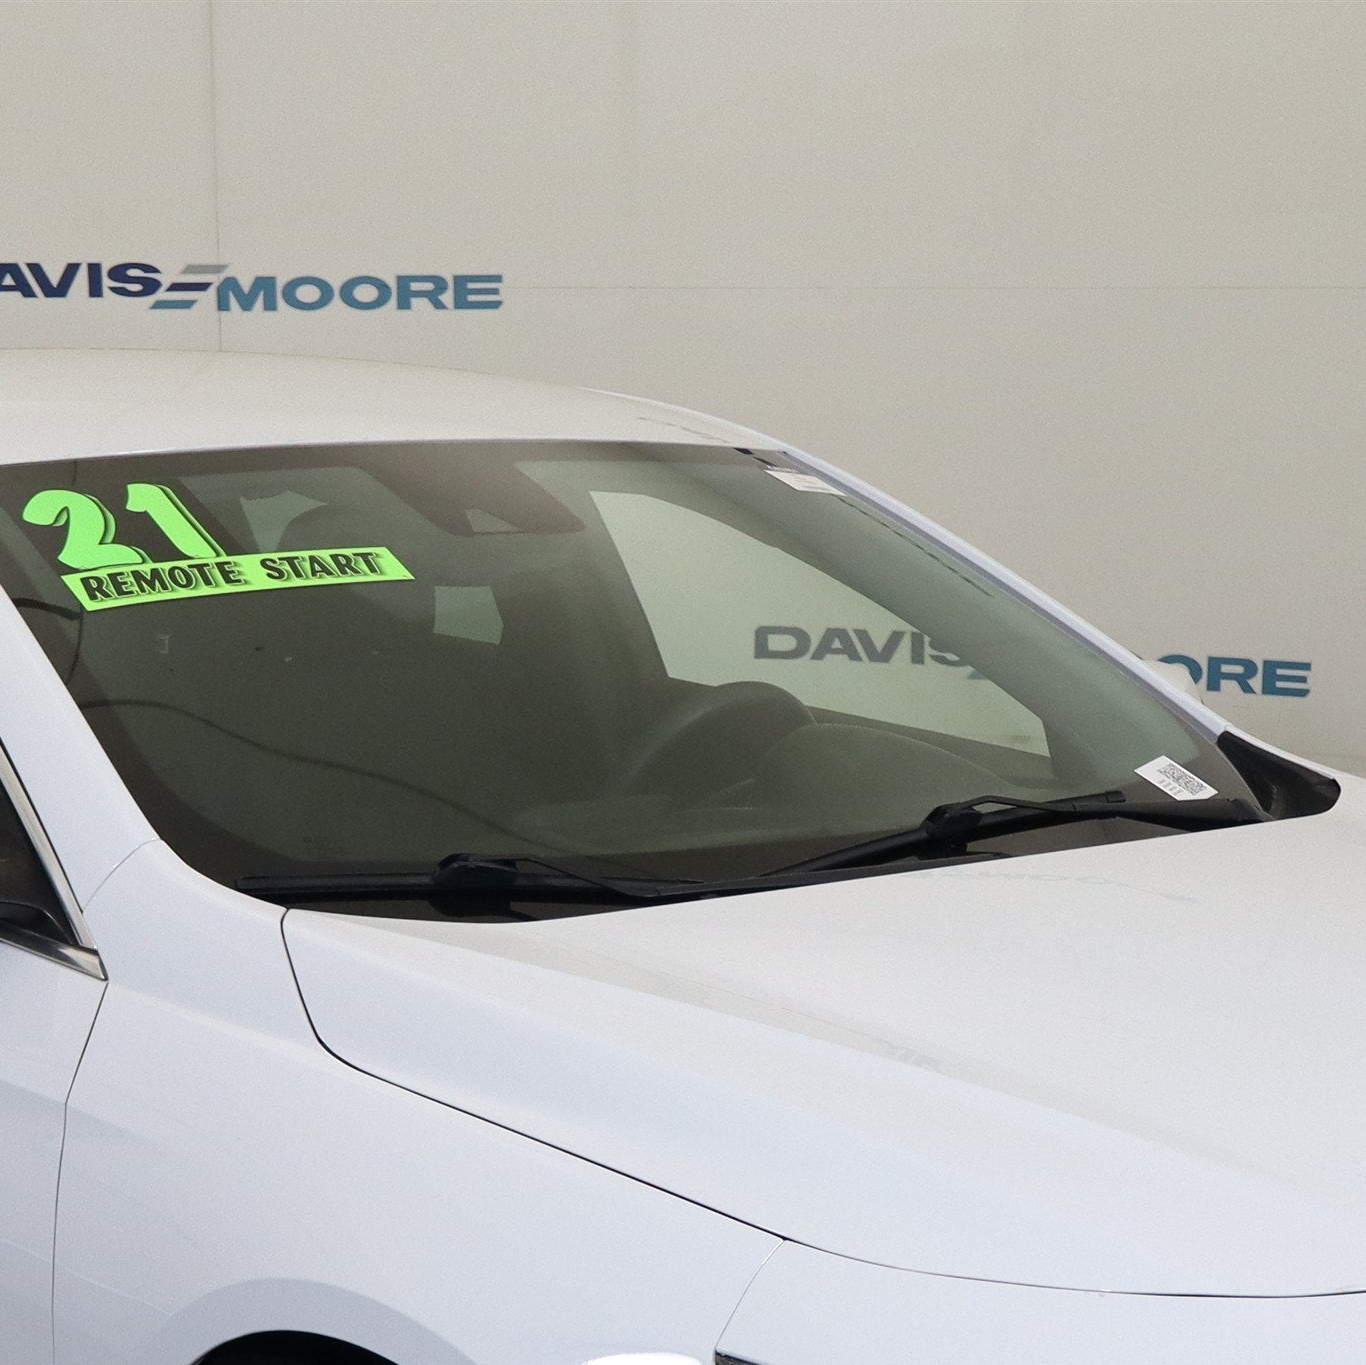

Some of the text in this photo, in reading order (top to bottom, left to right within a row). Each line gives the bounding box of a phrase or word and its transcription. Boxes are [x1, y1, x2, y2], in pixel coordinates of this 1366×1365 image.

[22, 482, 223, 570] 21
[79, 551, 381, 601] REMOTE START
